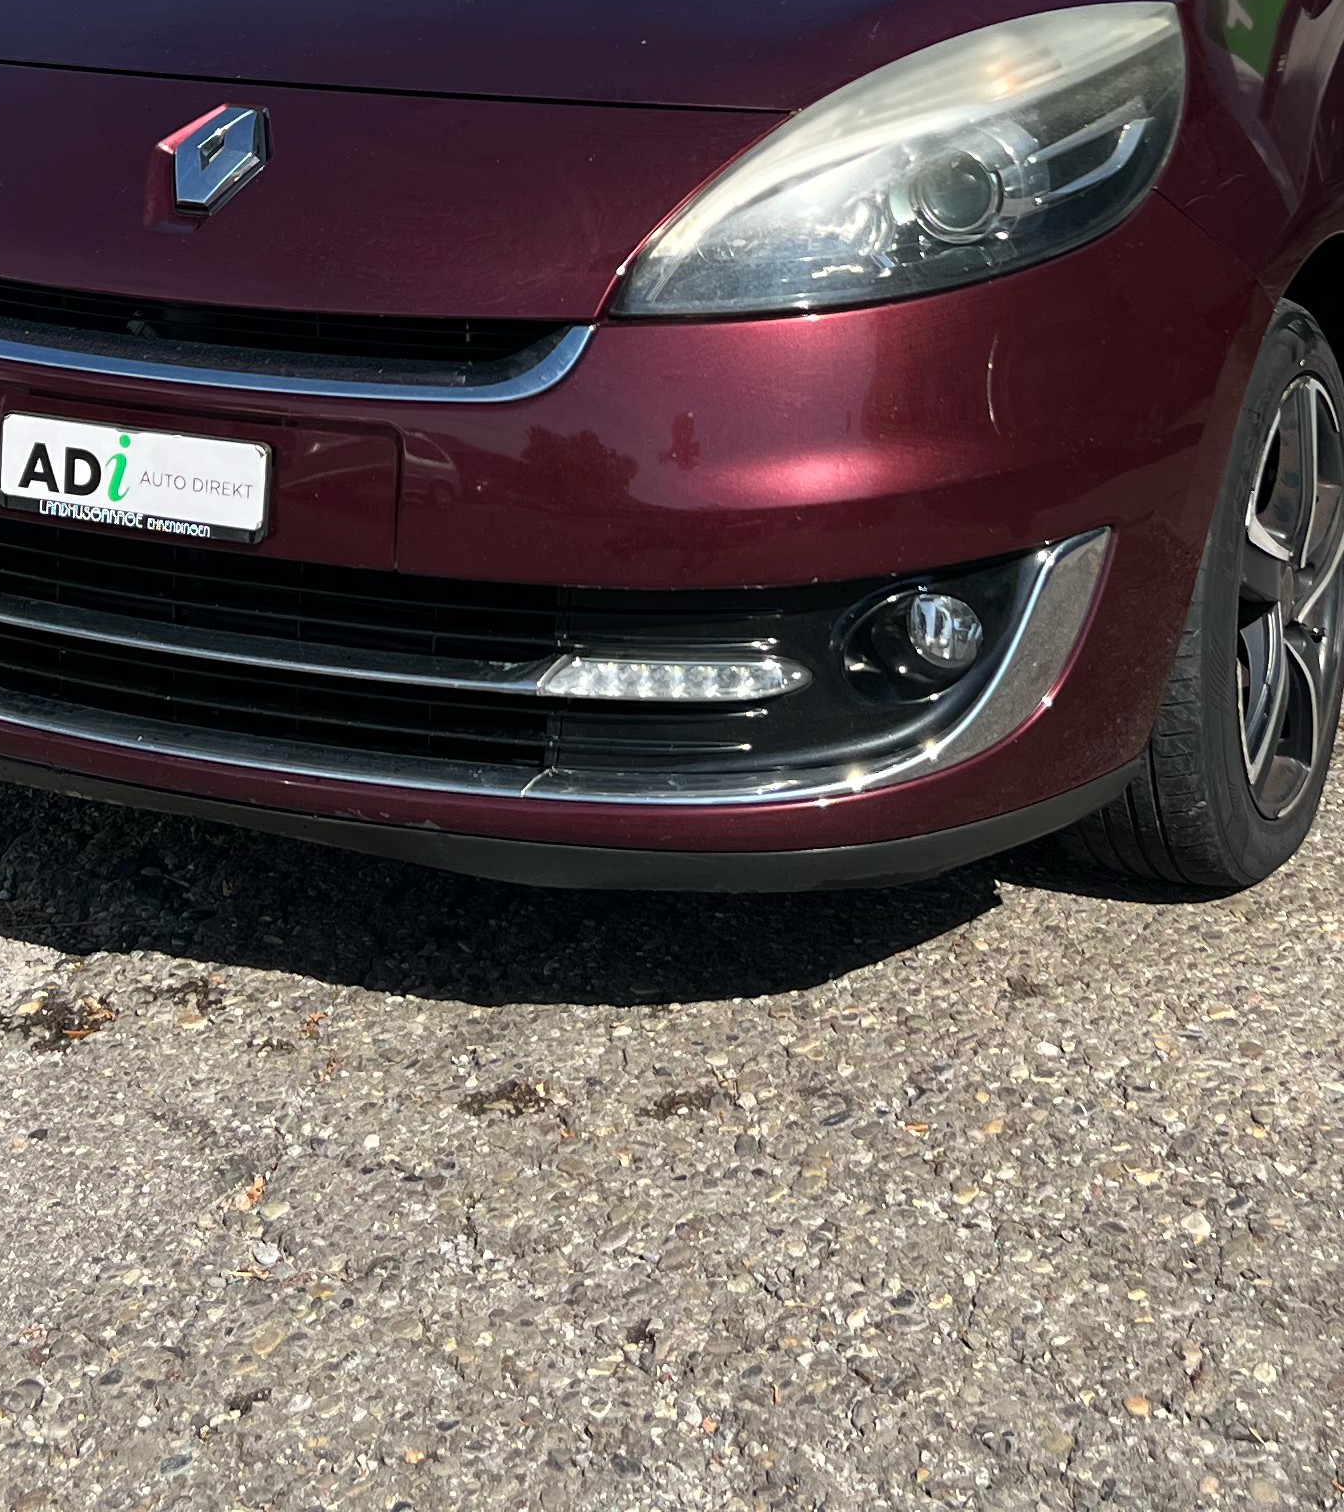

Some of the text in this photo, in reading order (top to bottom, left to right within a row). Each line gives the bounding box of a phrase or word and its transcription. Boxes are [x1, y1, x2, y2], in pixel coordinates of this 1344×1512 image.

[17, 434, 254, 502] ADi AUTO DIREKT
